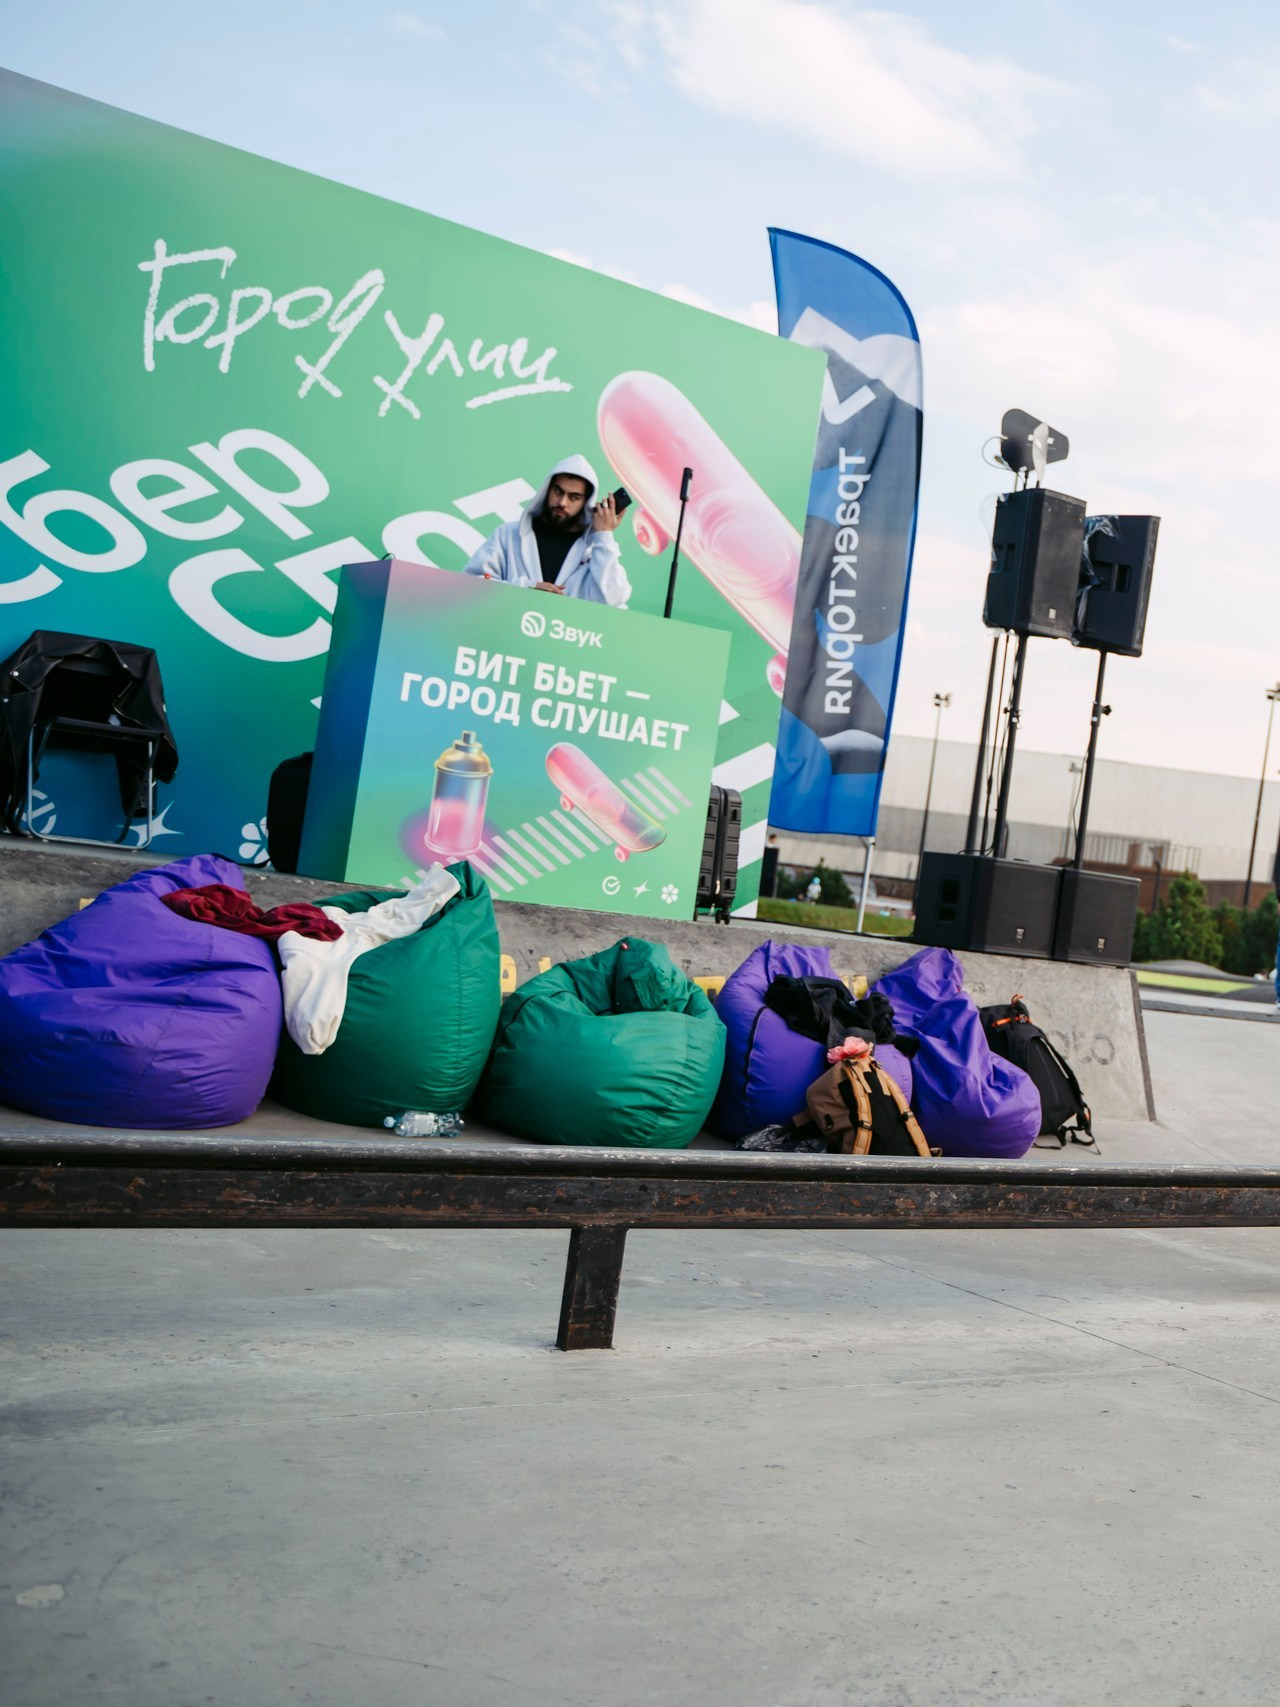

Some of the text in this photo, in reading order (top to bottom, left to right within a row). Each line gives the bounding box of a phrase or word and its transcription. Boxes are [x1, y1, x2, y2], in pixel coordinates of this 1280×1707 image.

[138, 238, 385, 399] Город
[549, 619, 604, 649] Звук
[454, 645, 527, 686] БИТ
[533, 661, 618, 704] БЬЕТ
[400, 671, 691, 752] ГОРОД СЛУШАЕТ
